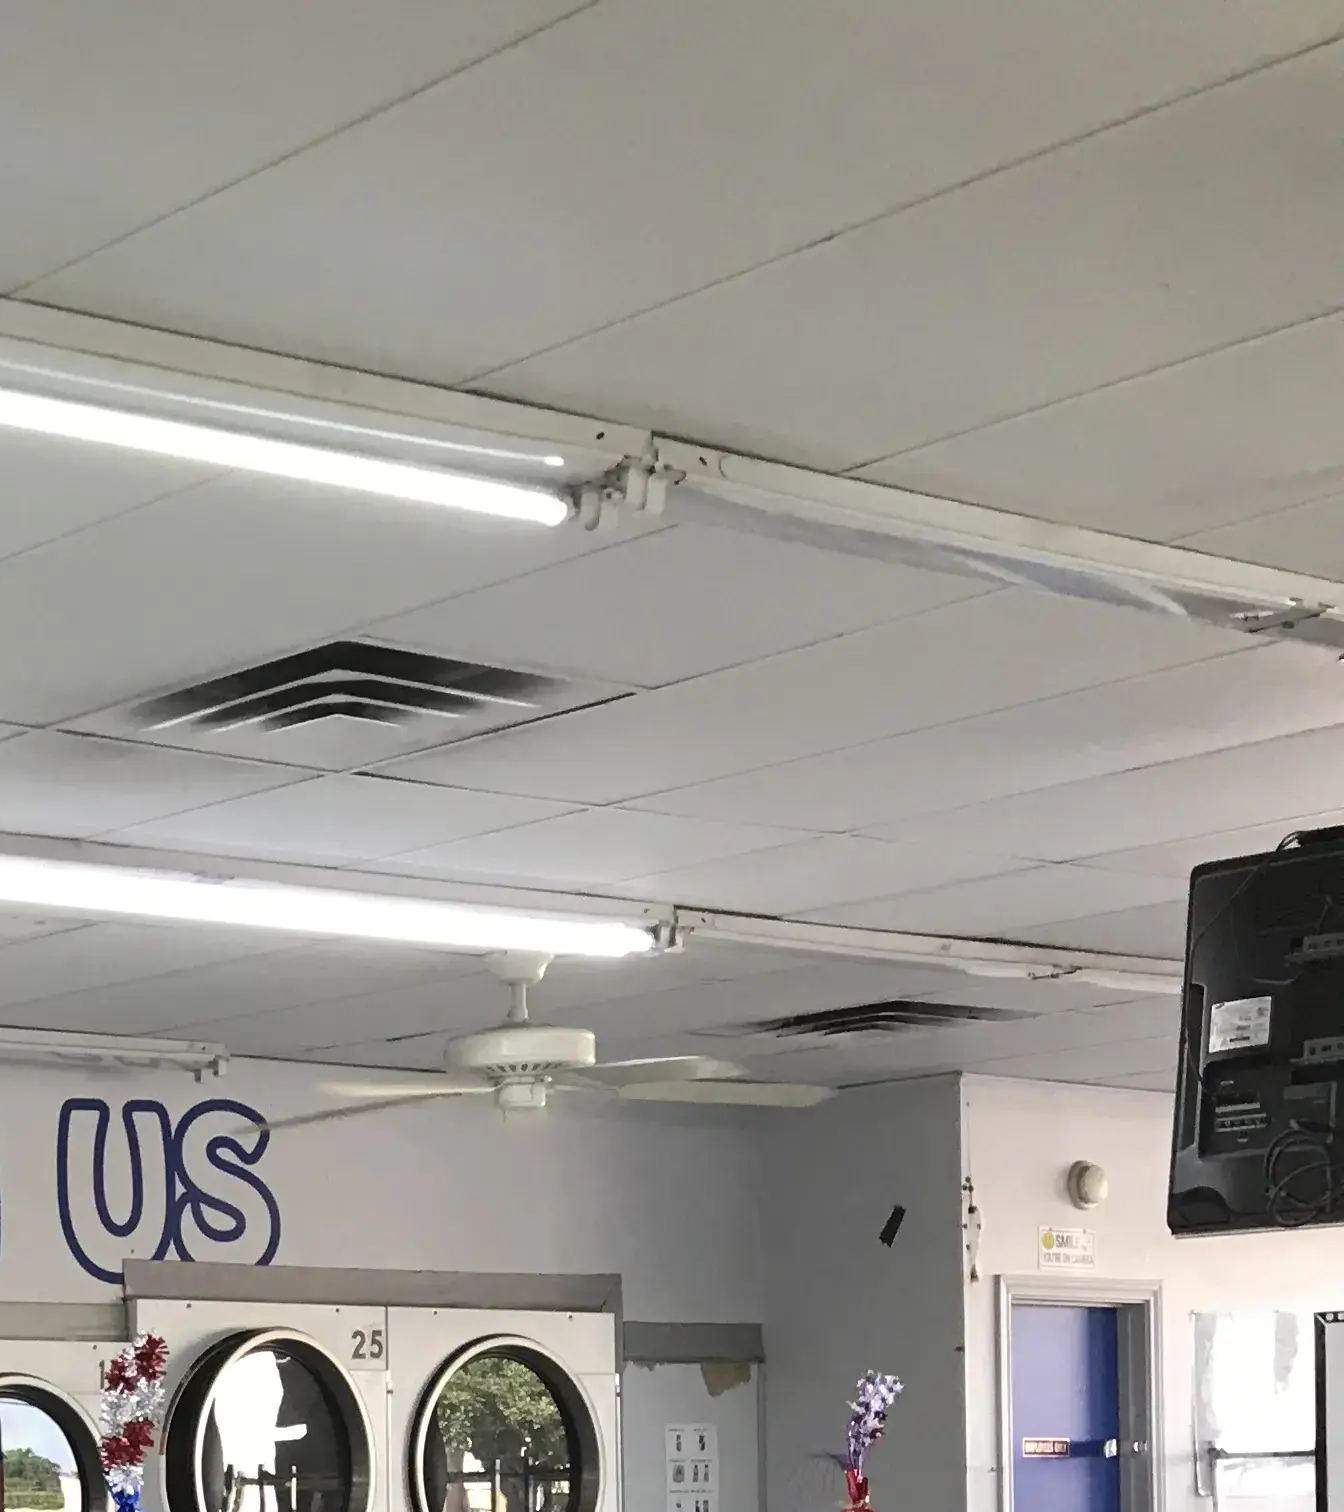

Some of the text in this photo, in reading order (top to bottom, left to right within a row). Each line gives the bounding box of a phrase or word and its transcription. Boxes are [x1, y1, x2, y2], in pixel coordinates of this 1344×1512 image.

[57, 1098, 280, 1284] US
[1055, 1234, 1080, 1250] SMILE
[351, 1330, 384, 1359] 25
